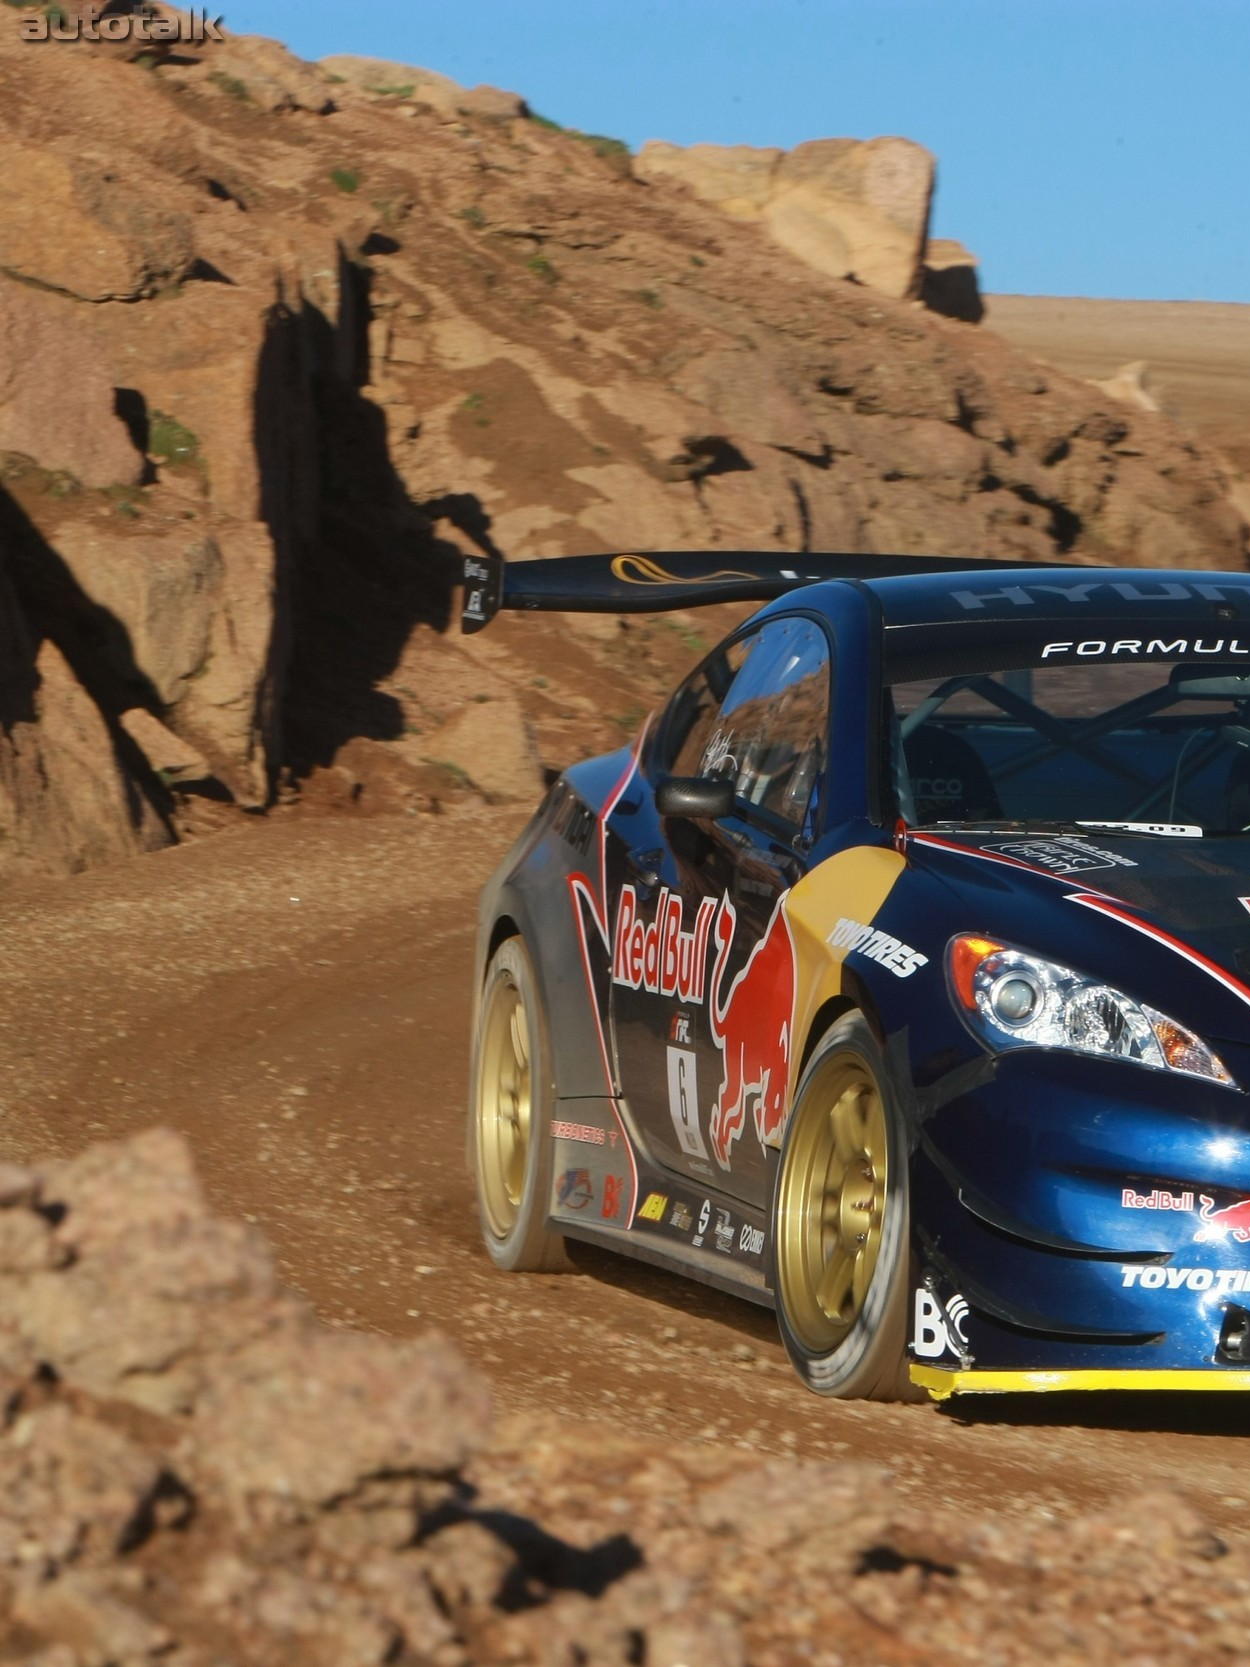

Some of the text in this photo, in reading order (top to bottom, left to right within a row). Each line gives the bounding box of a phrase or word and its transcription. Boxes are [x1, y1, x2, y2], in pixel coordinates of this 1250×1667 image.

[612, 884, 718, 1004] Red Bull
[825, 917, 929, 978] TOYO TIRES
[1122, 1189, 1194, 1212] Red Bull
[1120, 1265, 1215, 1291] TOYO
